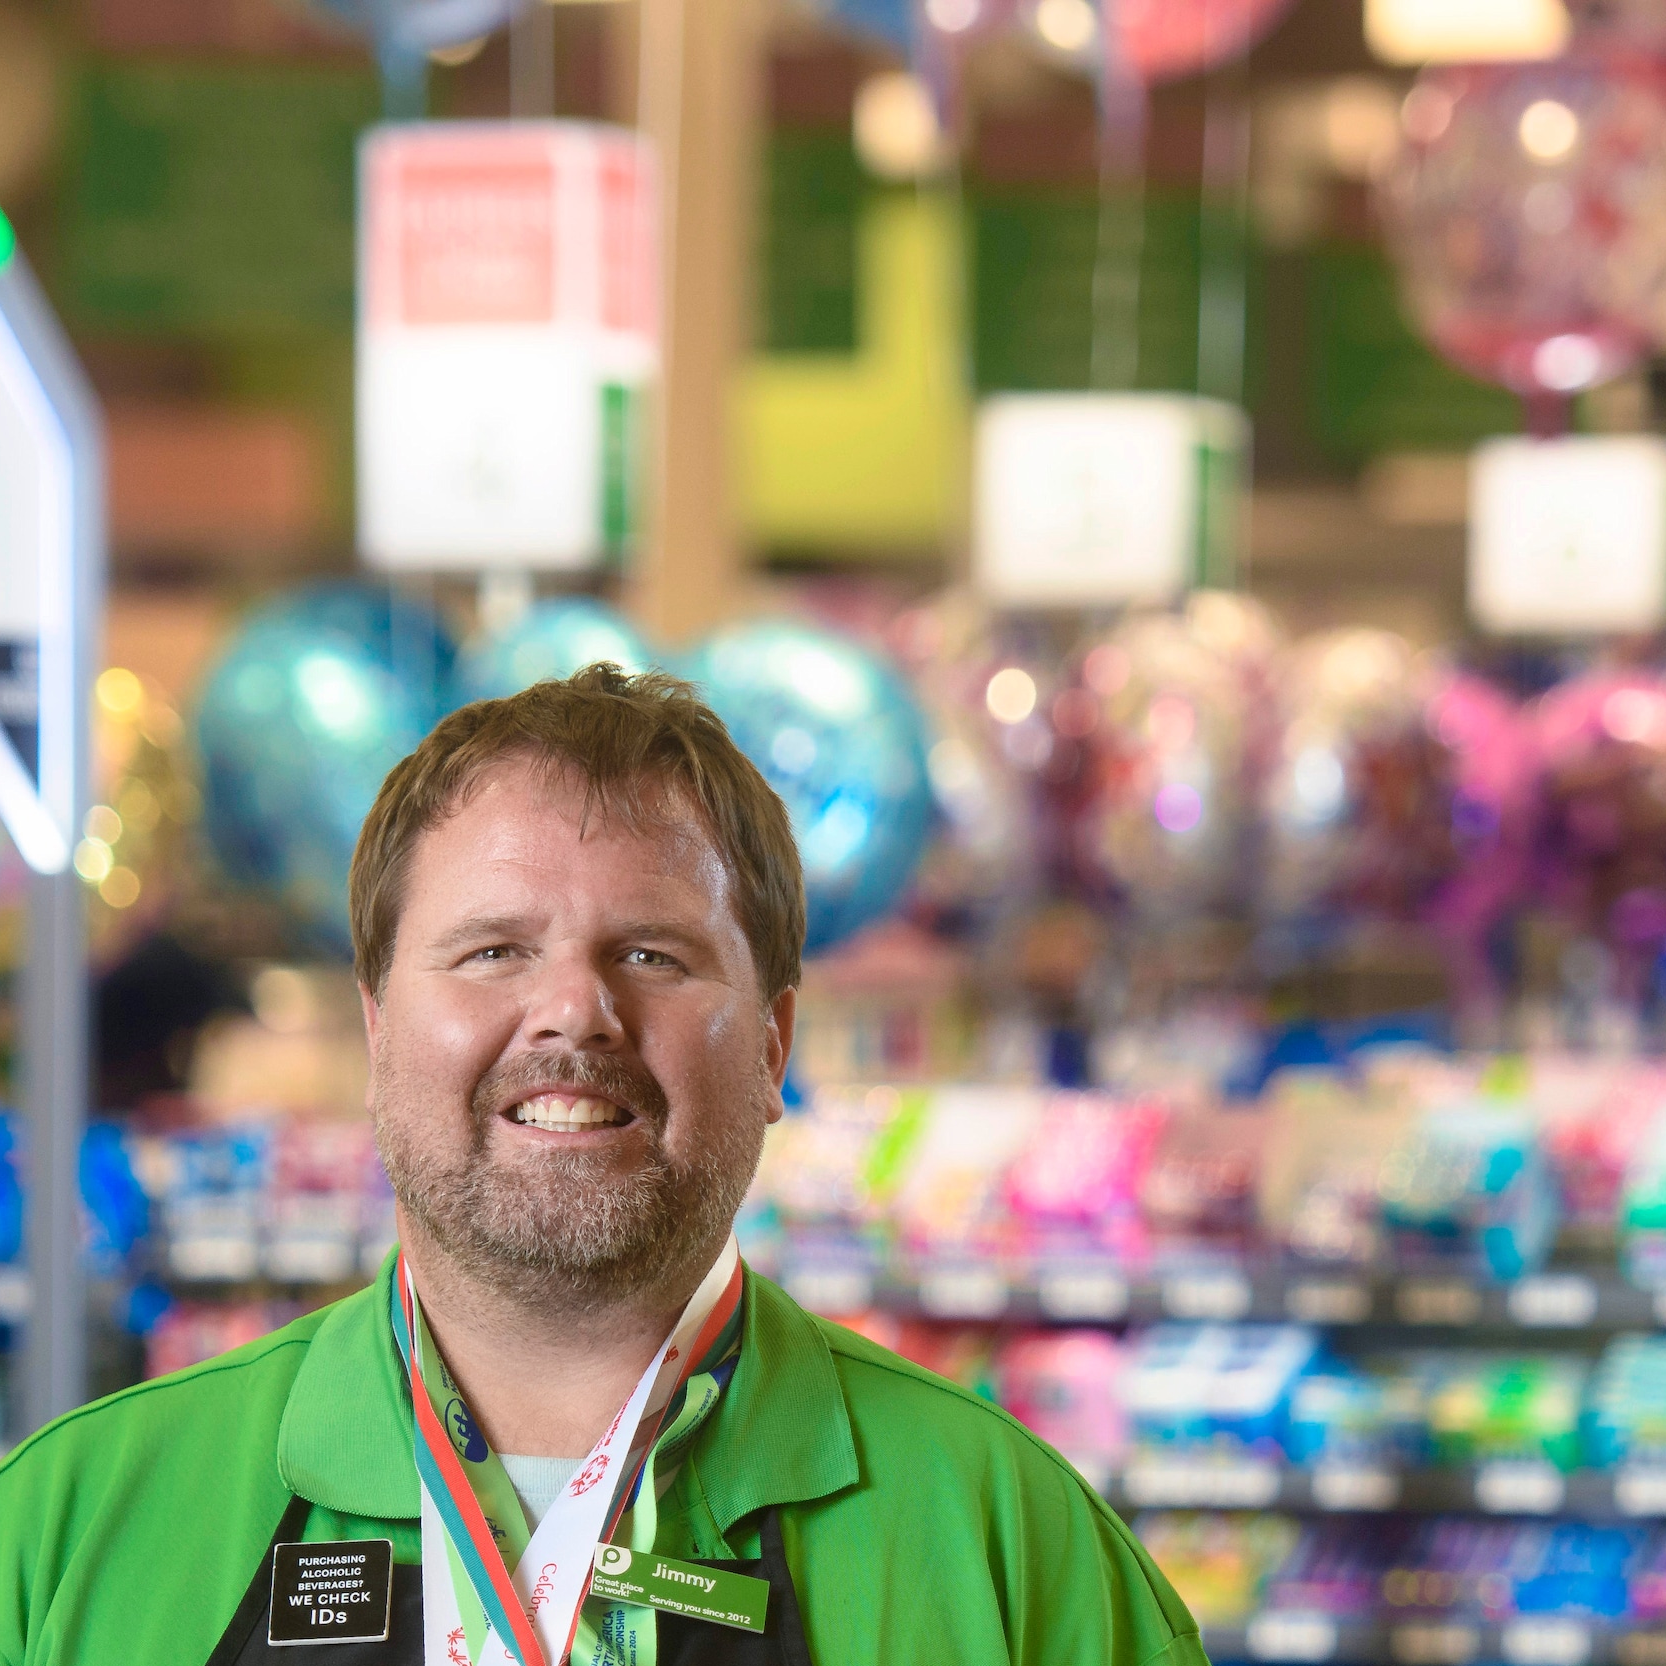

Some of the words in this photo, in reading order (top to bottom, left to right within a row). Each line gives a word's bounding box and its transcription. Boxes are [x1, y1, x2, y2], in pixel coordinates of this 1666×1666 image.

[298, 1555, 366, 1566] PURCHASING
[301, 1567, 361, 1578] ALCOHOLIC
[651, 1563, 717, 1594] Jimmy
[298, 1580, 364, 1591] BEVERAGES?
[594, 1575, 619, 1588] Great
[620, 1580, 644, 1593] place
[594, 1584, 604, 1592] to
[604, 1586, 630, 1598] work!
[289, 1594, 313, 1606] WE
[317, 1591, 371, 1605] CHECK
[310, 1608, 347, 1625] IDs
[649, 1594, 683, 1610] Serving
[683, 1603, 701, 1614] you
[702, 1607, 725, 1619] since
[727, 1612, 751, 1625] 2012
